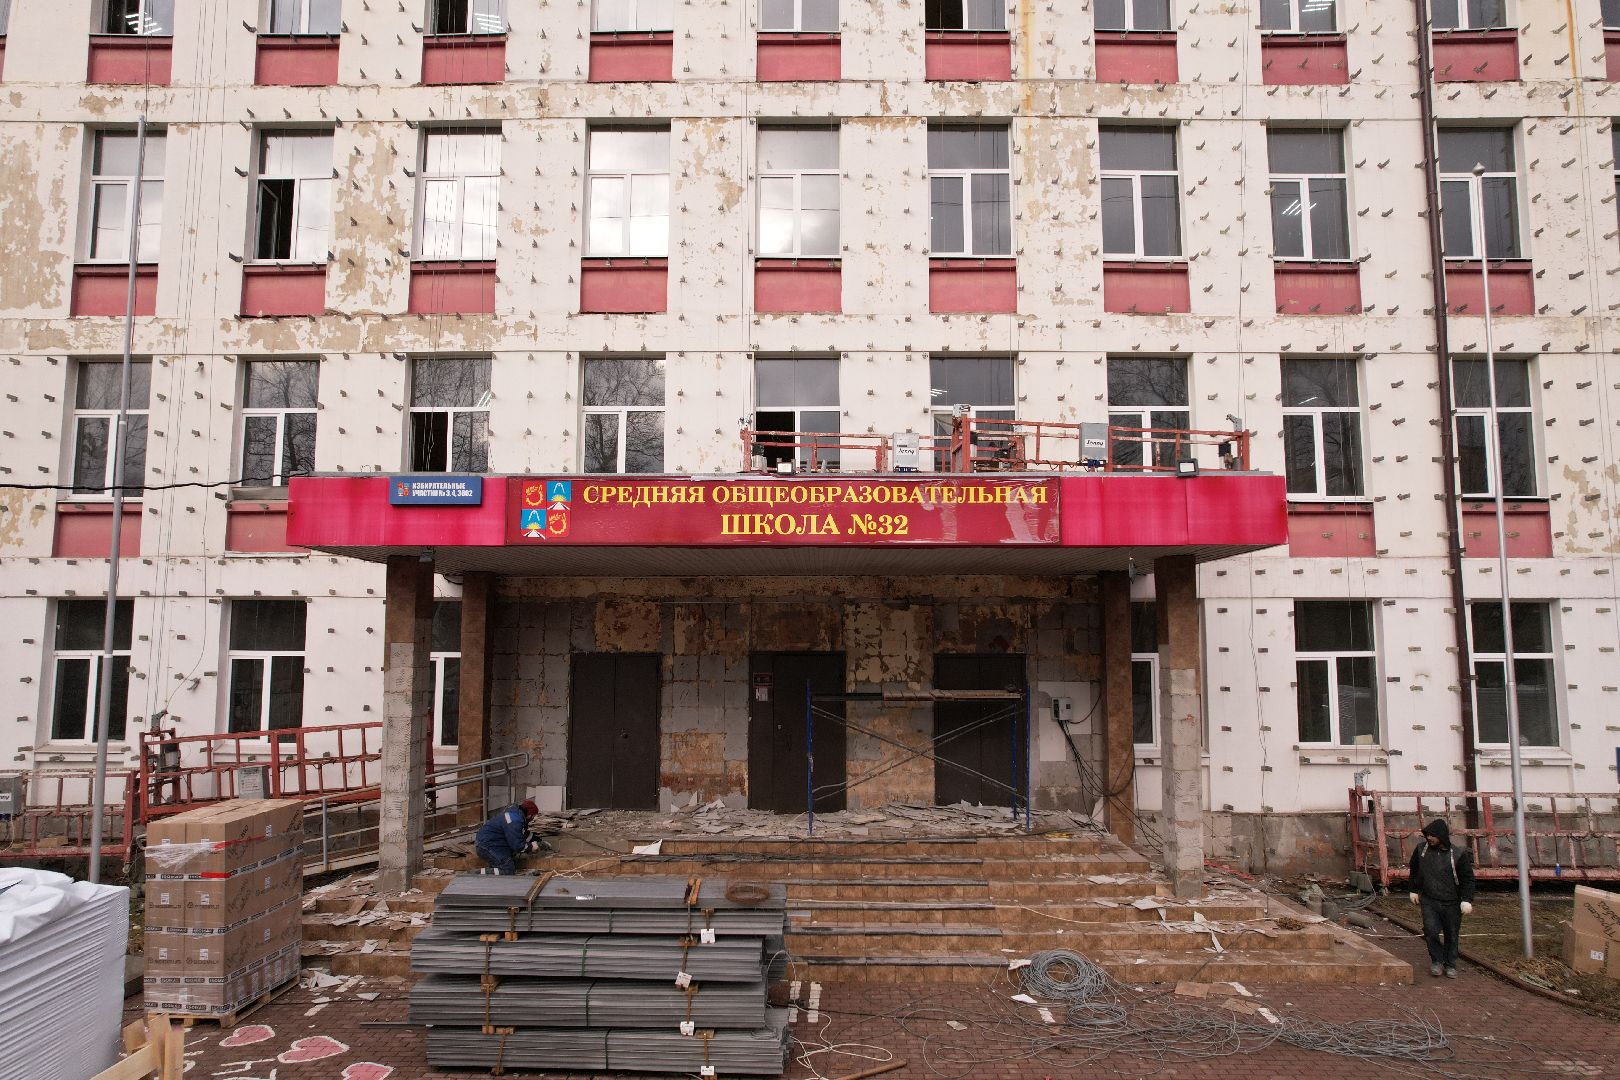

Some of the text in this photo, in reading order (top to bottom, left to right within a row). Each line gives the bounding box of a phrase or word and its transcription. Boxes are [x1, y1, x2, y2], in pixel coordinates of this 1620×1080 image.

[583, 485, 1048, 508] СРЕДНЯЯ ОБЩЕОБРАЗОВАТЕЛЬНАЯ
[720, 513, 909, 536] ШКОЛА №32
